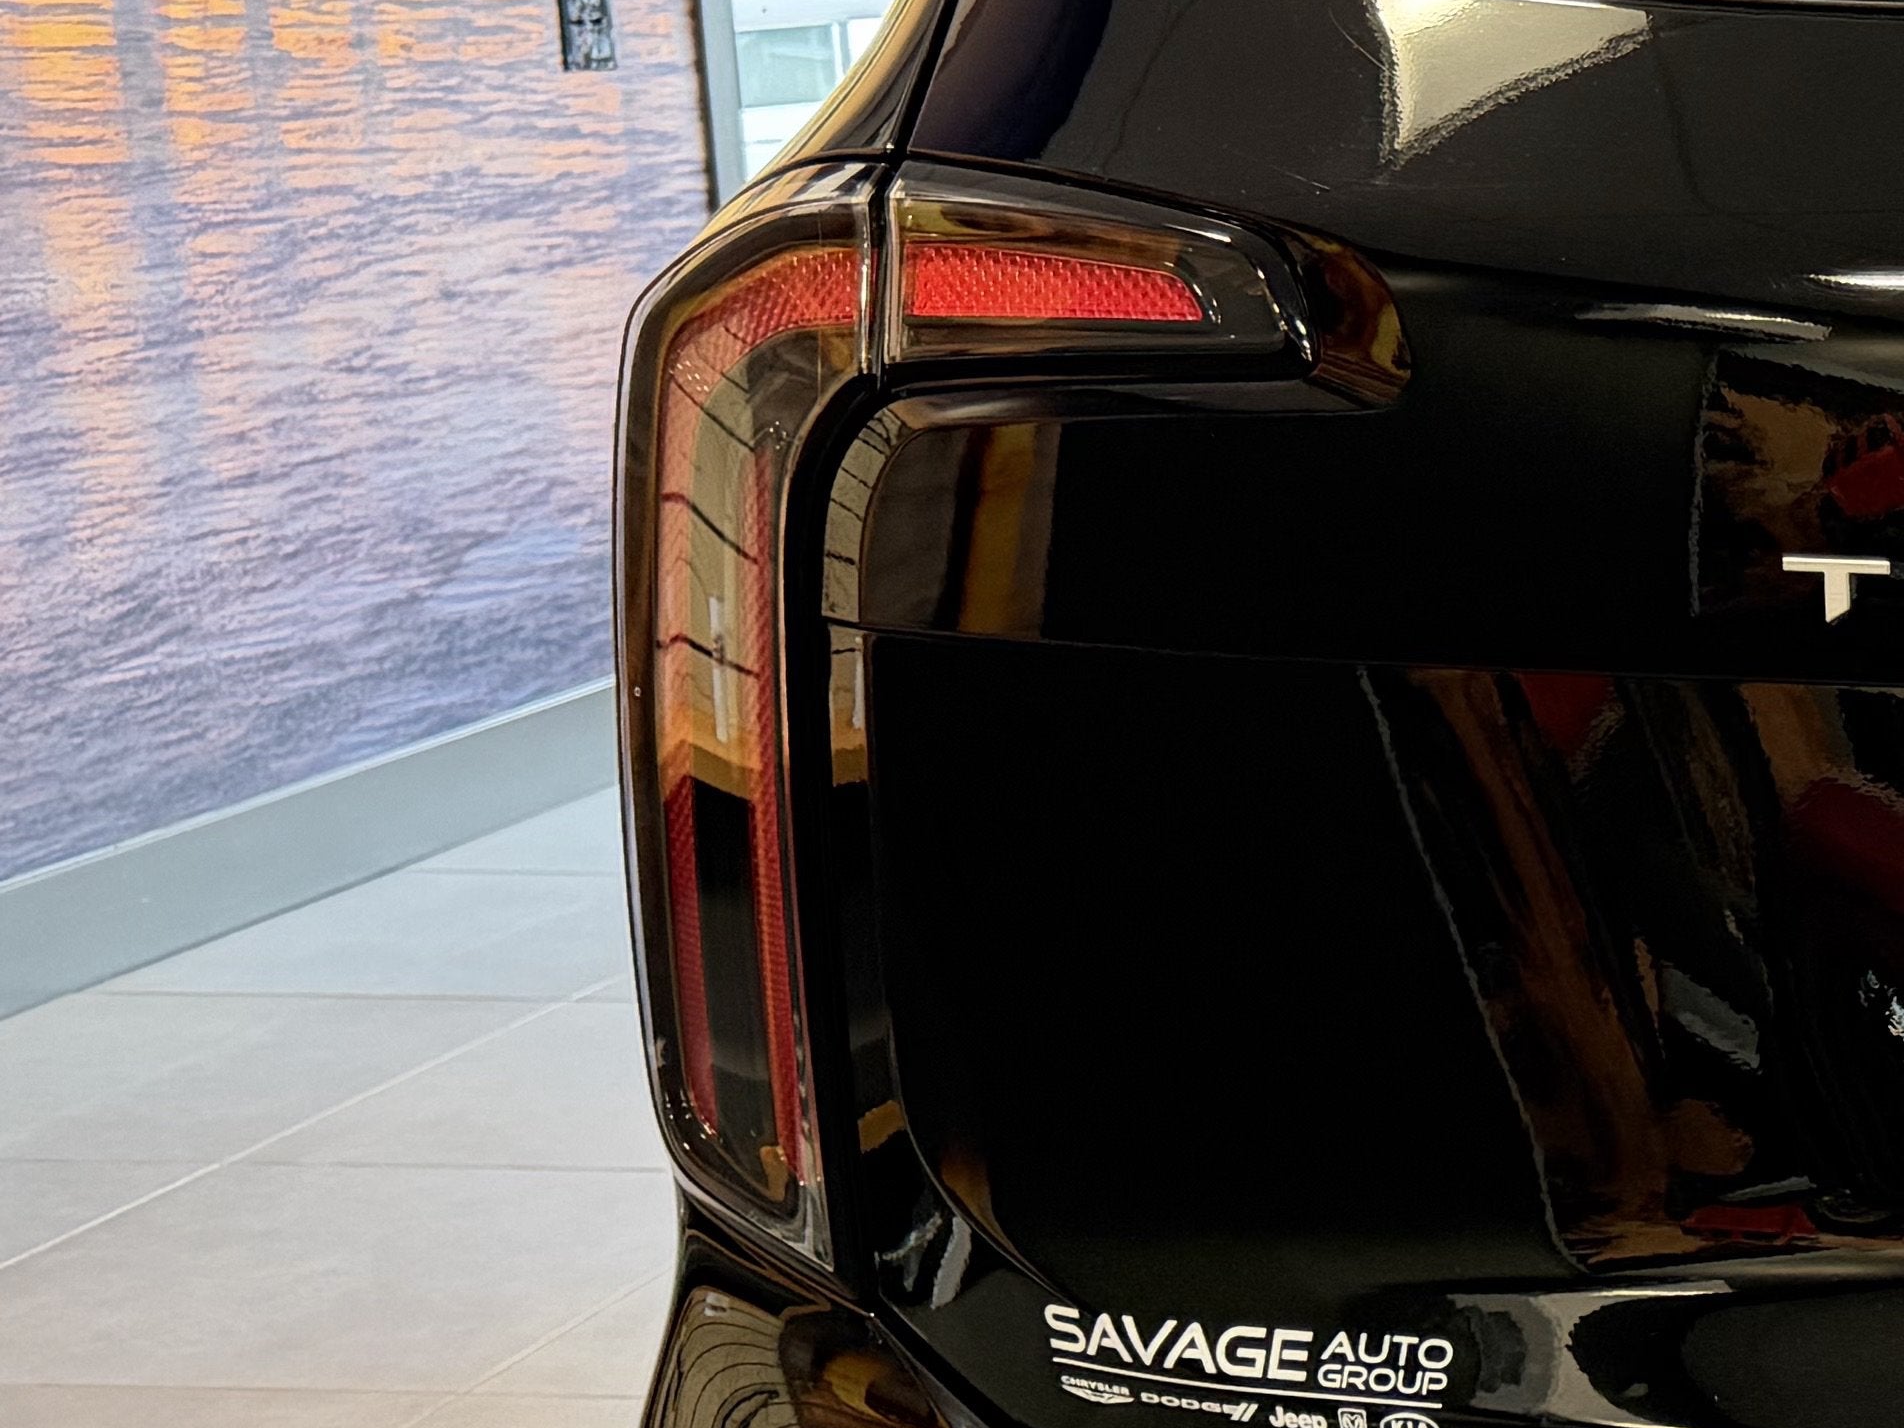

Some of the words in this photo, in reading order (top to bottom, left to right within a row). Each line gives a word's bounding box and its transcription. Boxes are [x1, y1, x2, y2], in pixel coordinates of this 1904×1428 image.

[1044, 1304, 1314, 1382] SAVAGE
[1320, 1331, 1454, 1369] AUTO
[1318, 1365, 1448, 1397] GROUP
